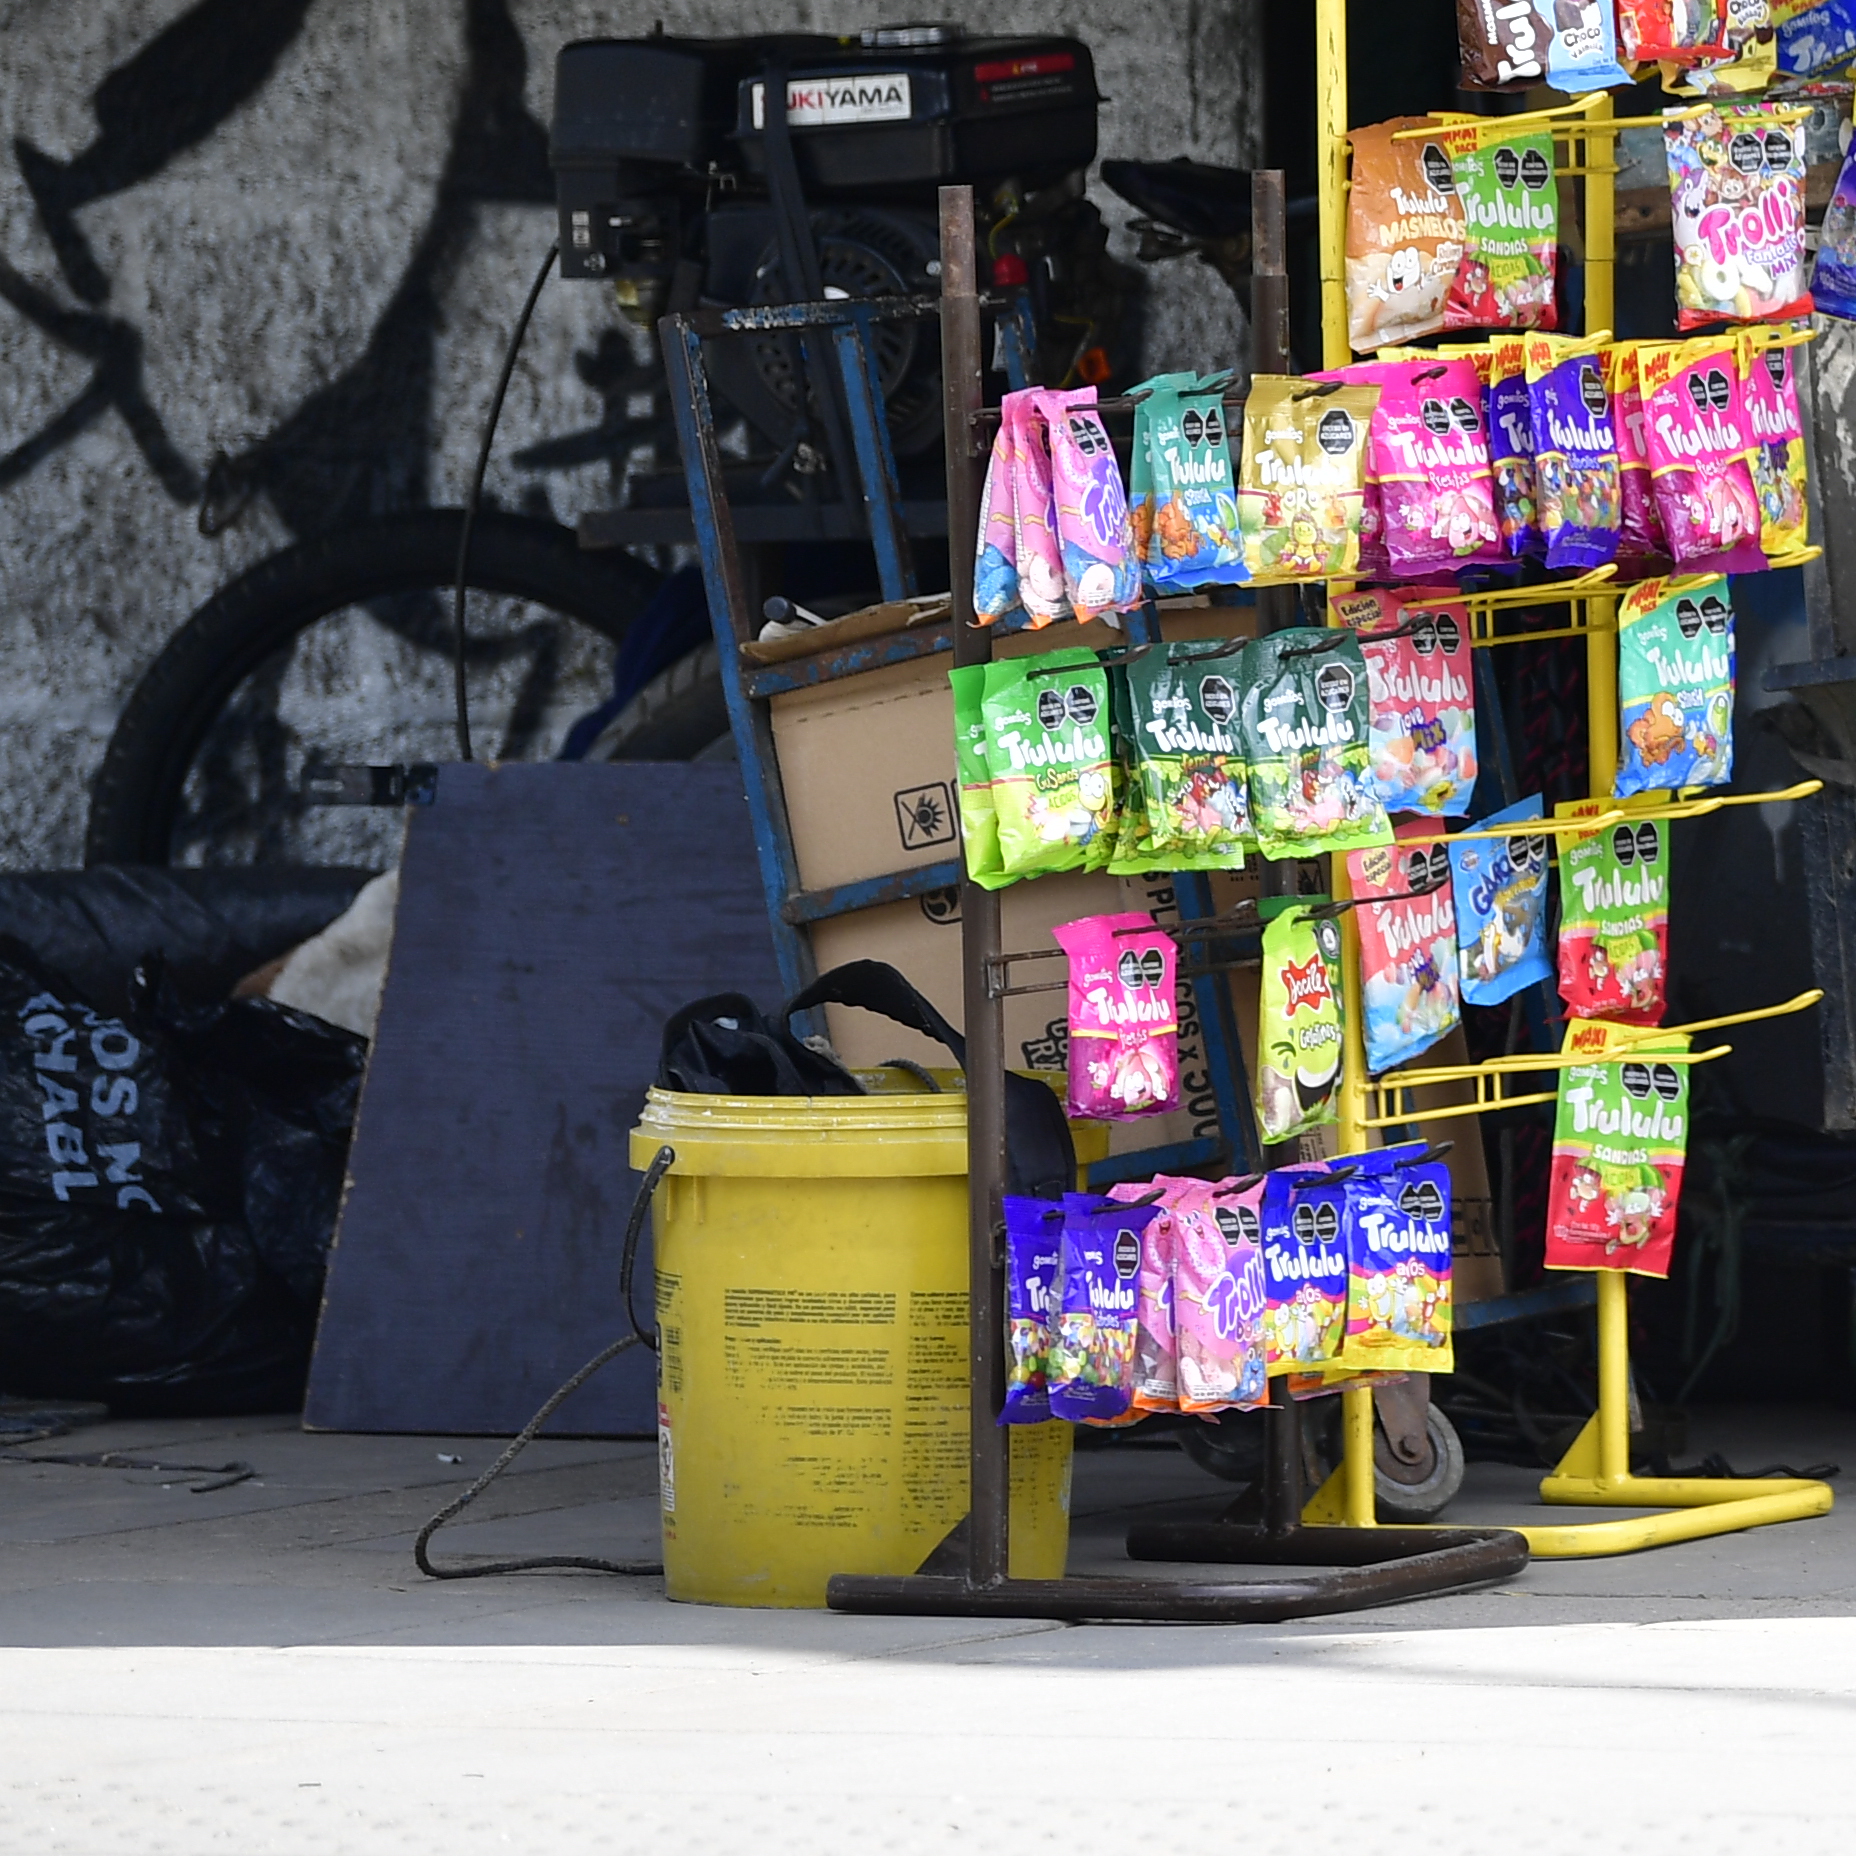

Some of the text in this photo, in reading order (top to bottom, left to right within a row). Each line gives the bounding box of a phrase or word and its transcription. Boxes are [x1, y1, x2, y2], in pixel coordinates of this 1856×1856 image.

[1390, 187, 1448, 215] Trululu
[1379, 216, 1466, 246] MASMELOS
[1699, 178, 1795, 265] Trolli
[1389, 431, 1488, 468] Trululu
[1655, 411, 1741, 459] Trululu
[1255, 451, 1350, 486] Trululu
[997, 728, 1104, 771] Trululu
[1146, 717, 1233, 754] Trululu
[1257, 712, 1354, 752] Trululu
[1572, 864, 1665, 913] Trululu
[1086, 987, 1171, 1025] Trululu
[1566, 1088, 1682, 1141] Trululu
[1359, 1213, 1449, 1254] Trululu
[1265, 1244, 1345, 1281] Trululu
